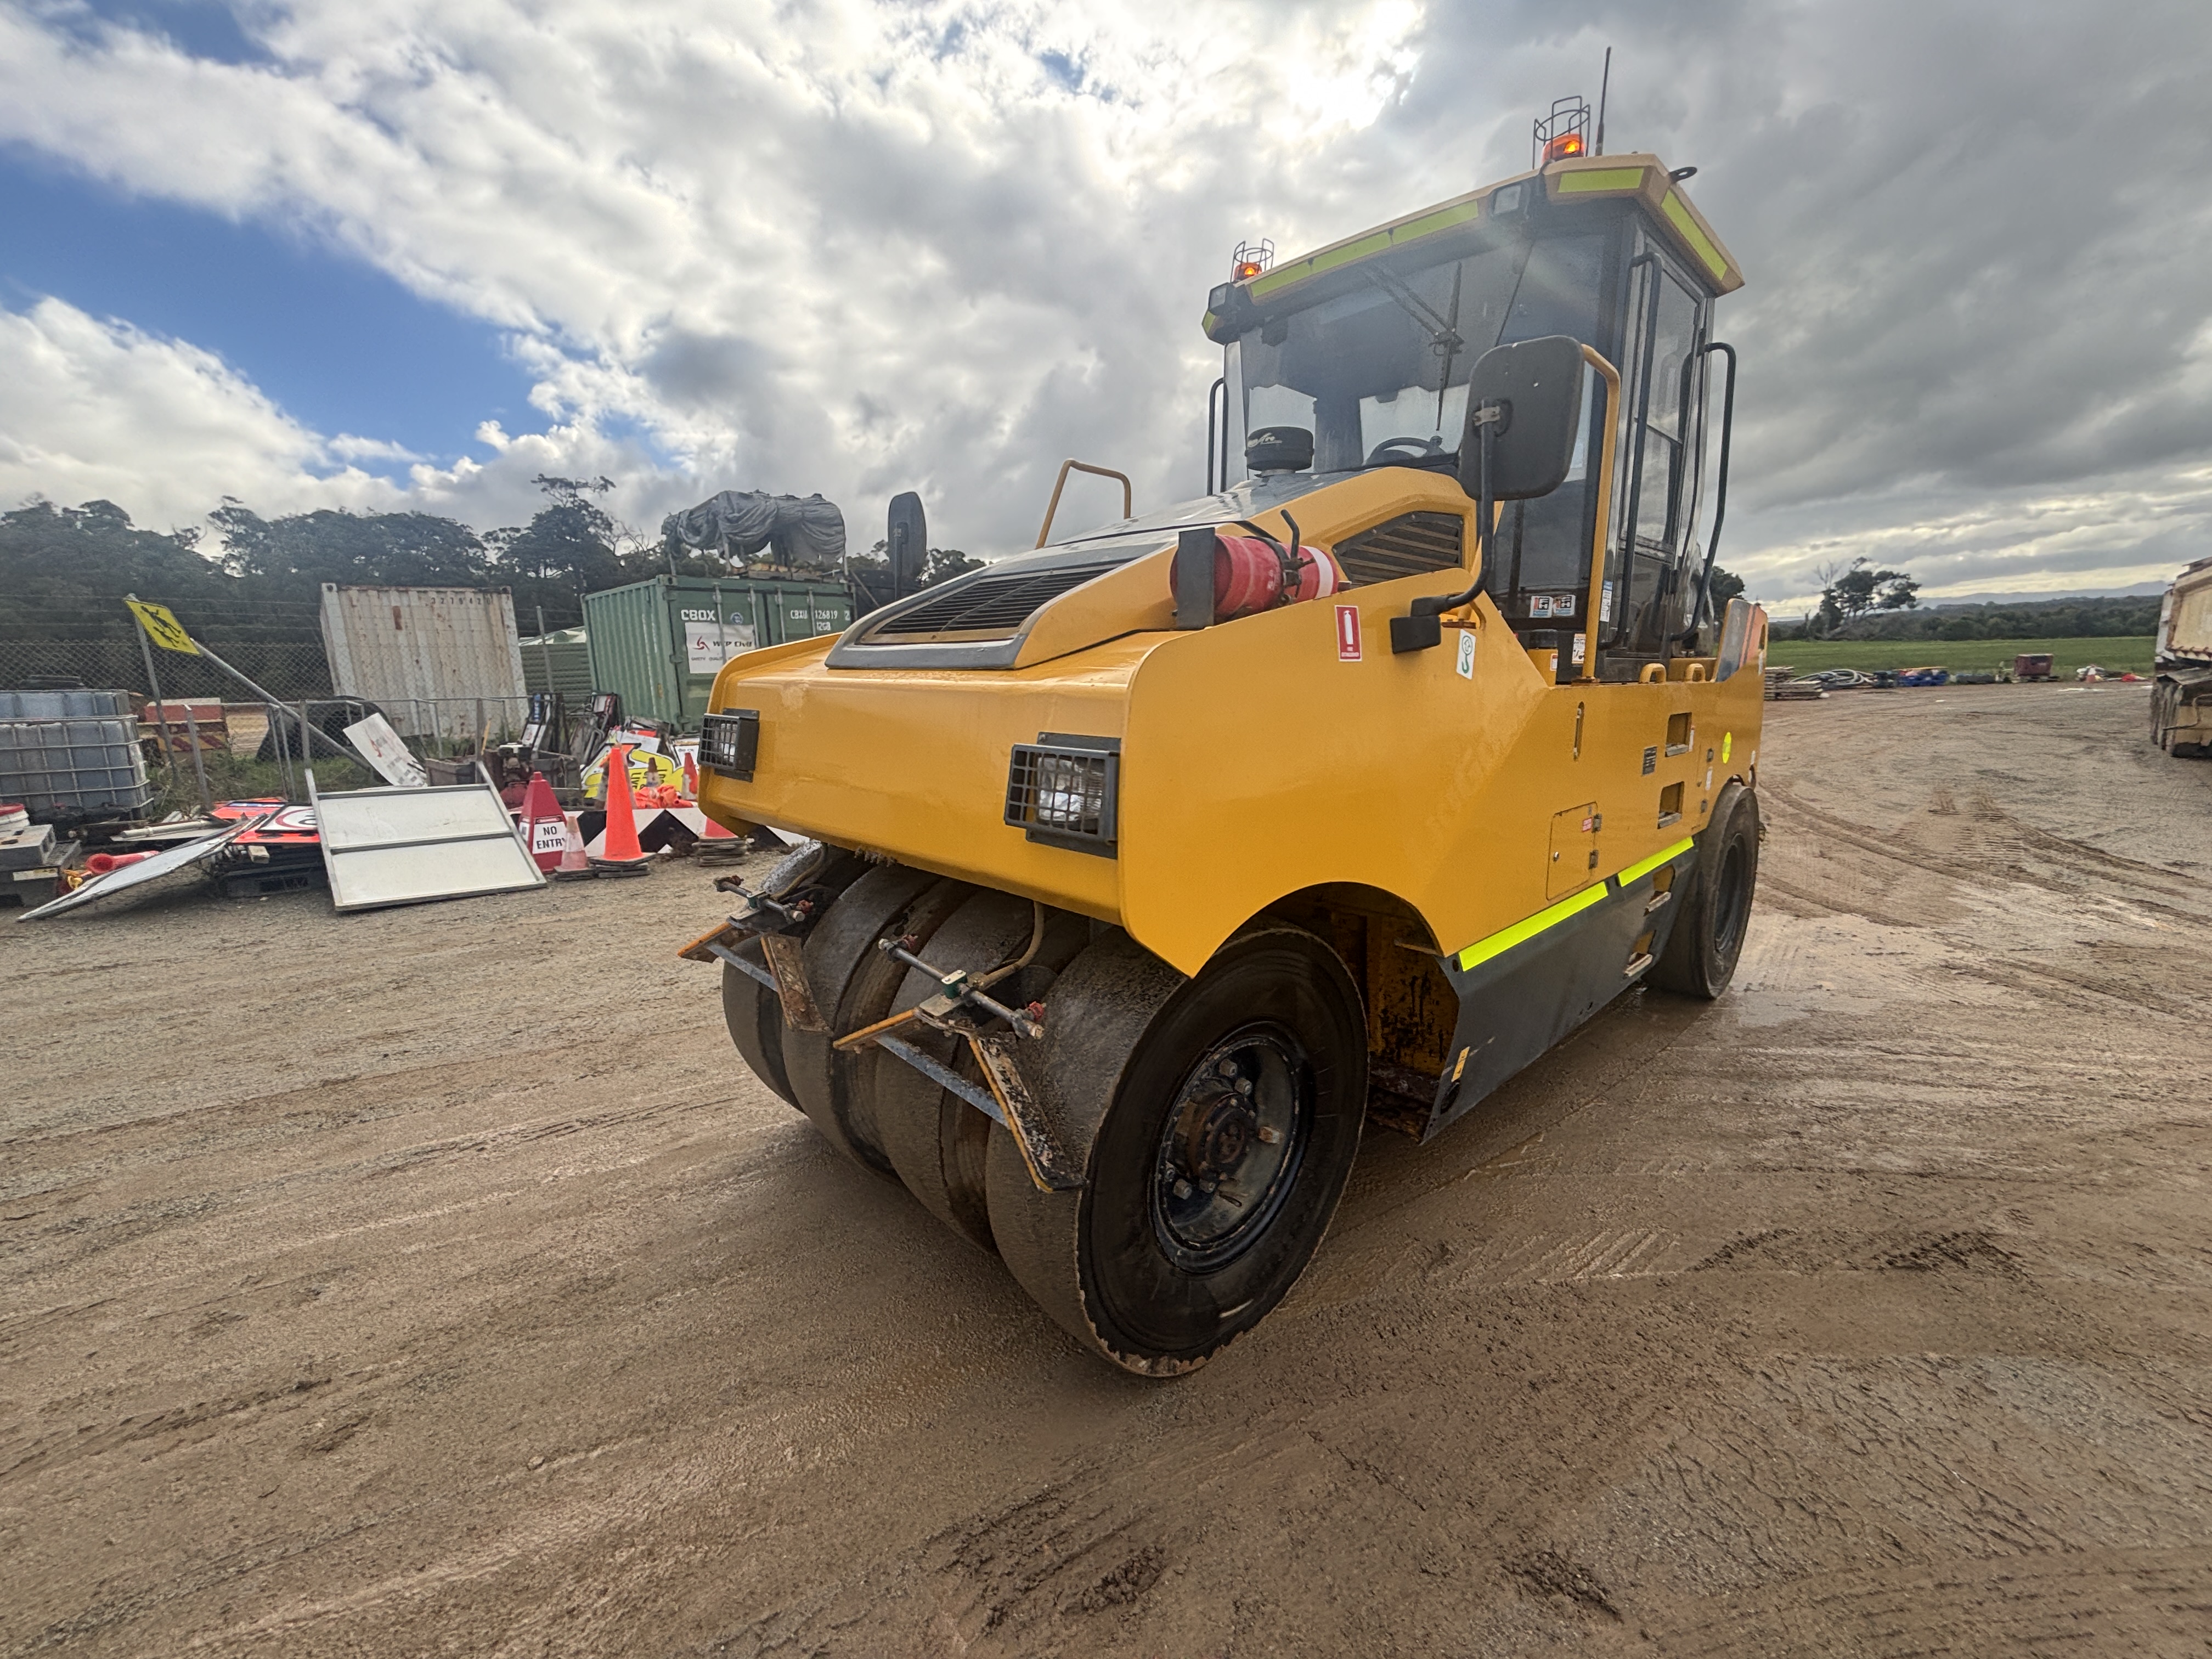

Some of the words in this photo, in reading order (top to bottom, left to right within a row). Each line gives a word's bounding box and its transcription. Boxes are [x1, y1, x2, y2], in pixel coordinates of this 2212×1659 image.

[681, 610, 715, 621] CBOX
[791, 610, 808, 619] CBXU
[815, 610, 838, 619] 126819
[543, 826, 557, 836] NO
